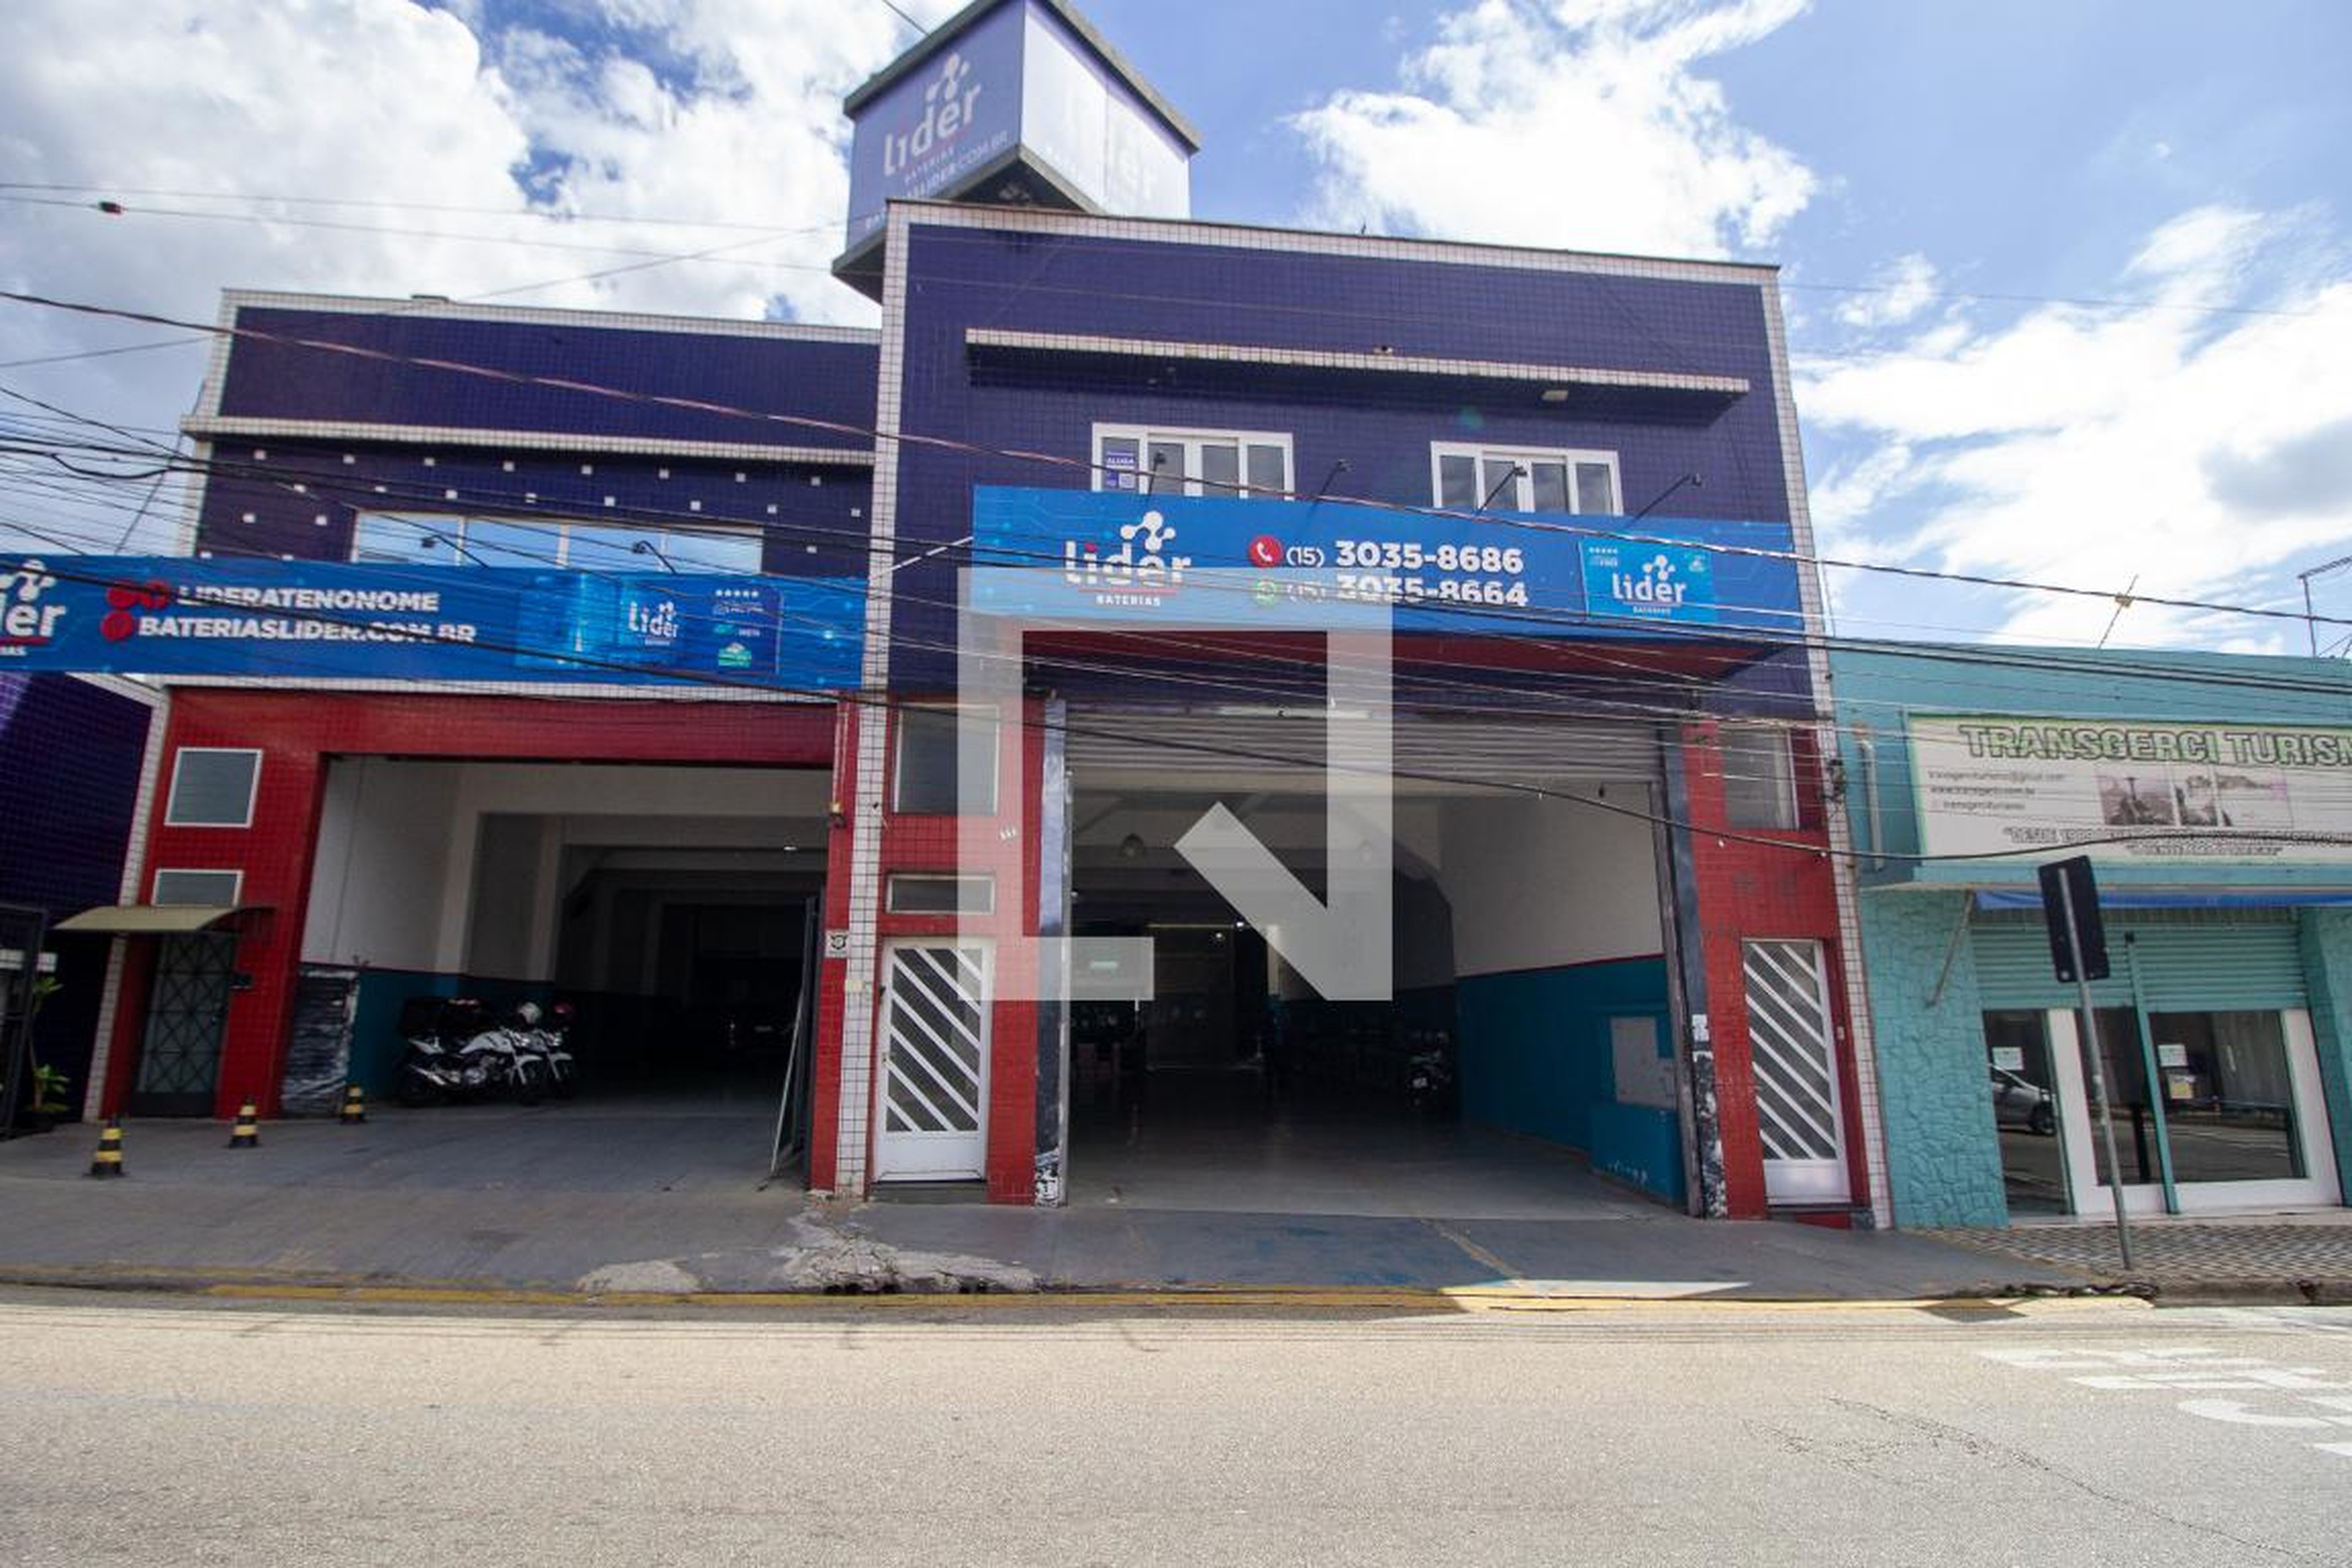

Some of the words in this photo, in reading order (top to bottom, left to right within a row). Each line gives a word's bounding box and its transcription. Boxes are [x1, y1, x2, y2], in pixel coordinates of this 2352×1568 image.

[1286, 546, 1325, 567] (15)
[1336, 540, 1524, 575] 3035-8686
[1337, 575, 1528, 606] 3035-8664
[1958, 725, 2221, 764] TRANSGERCI
